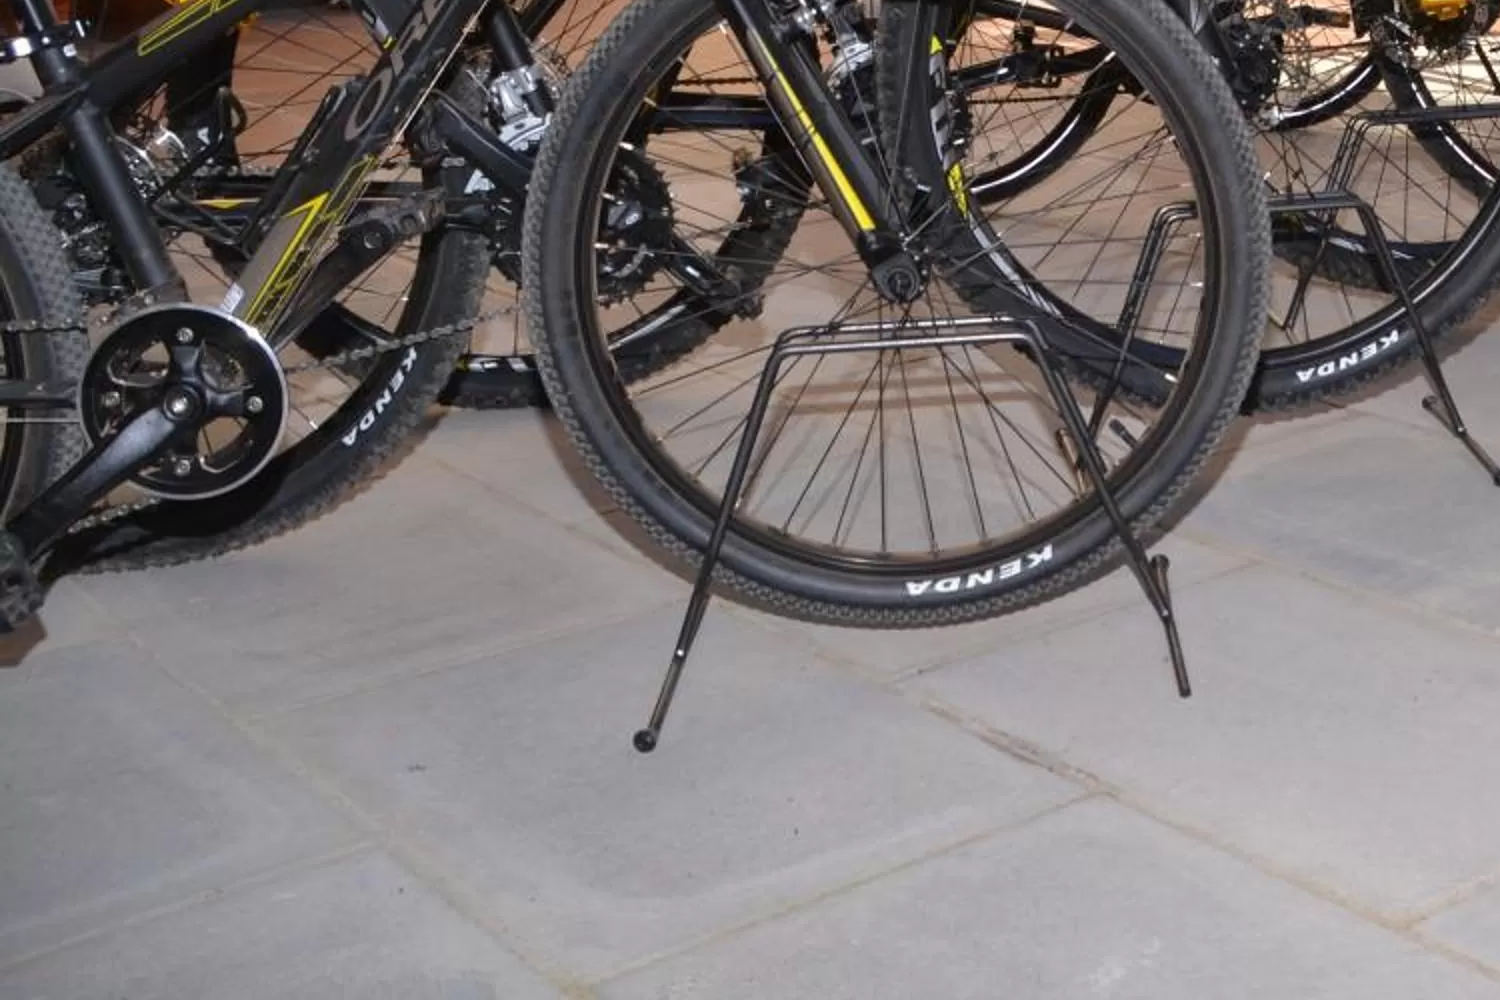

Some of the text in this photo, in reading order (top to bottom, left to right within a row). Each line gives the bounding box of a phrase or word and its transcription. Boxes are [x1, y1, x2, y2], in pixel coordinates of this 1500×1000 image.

[1296, 329, 1399, 382] KENDA
[341, 346, 417, 446] KENDA
[905, 543, 1053, 596] KENDA
